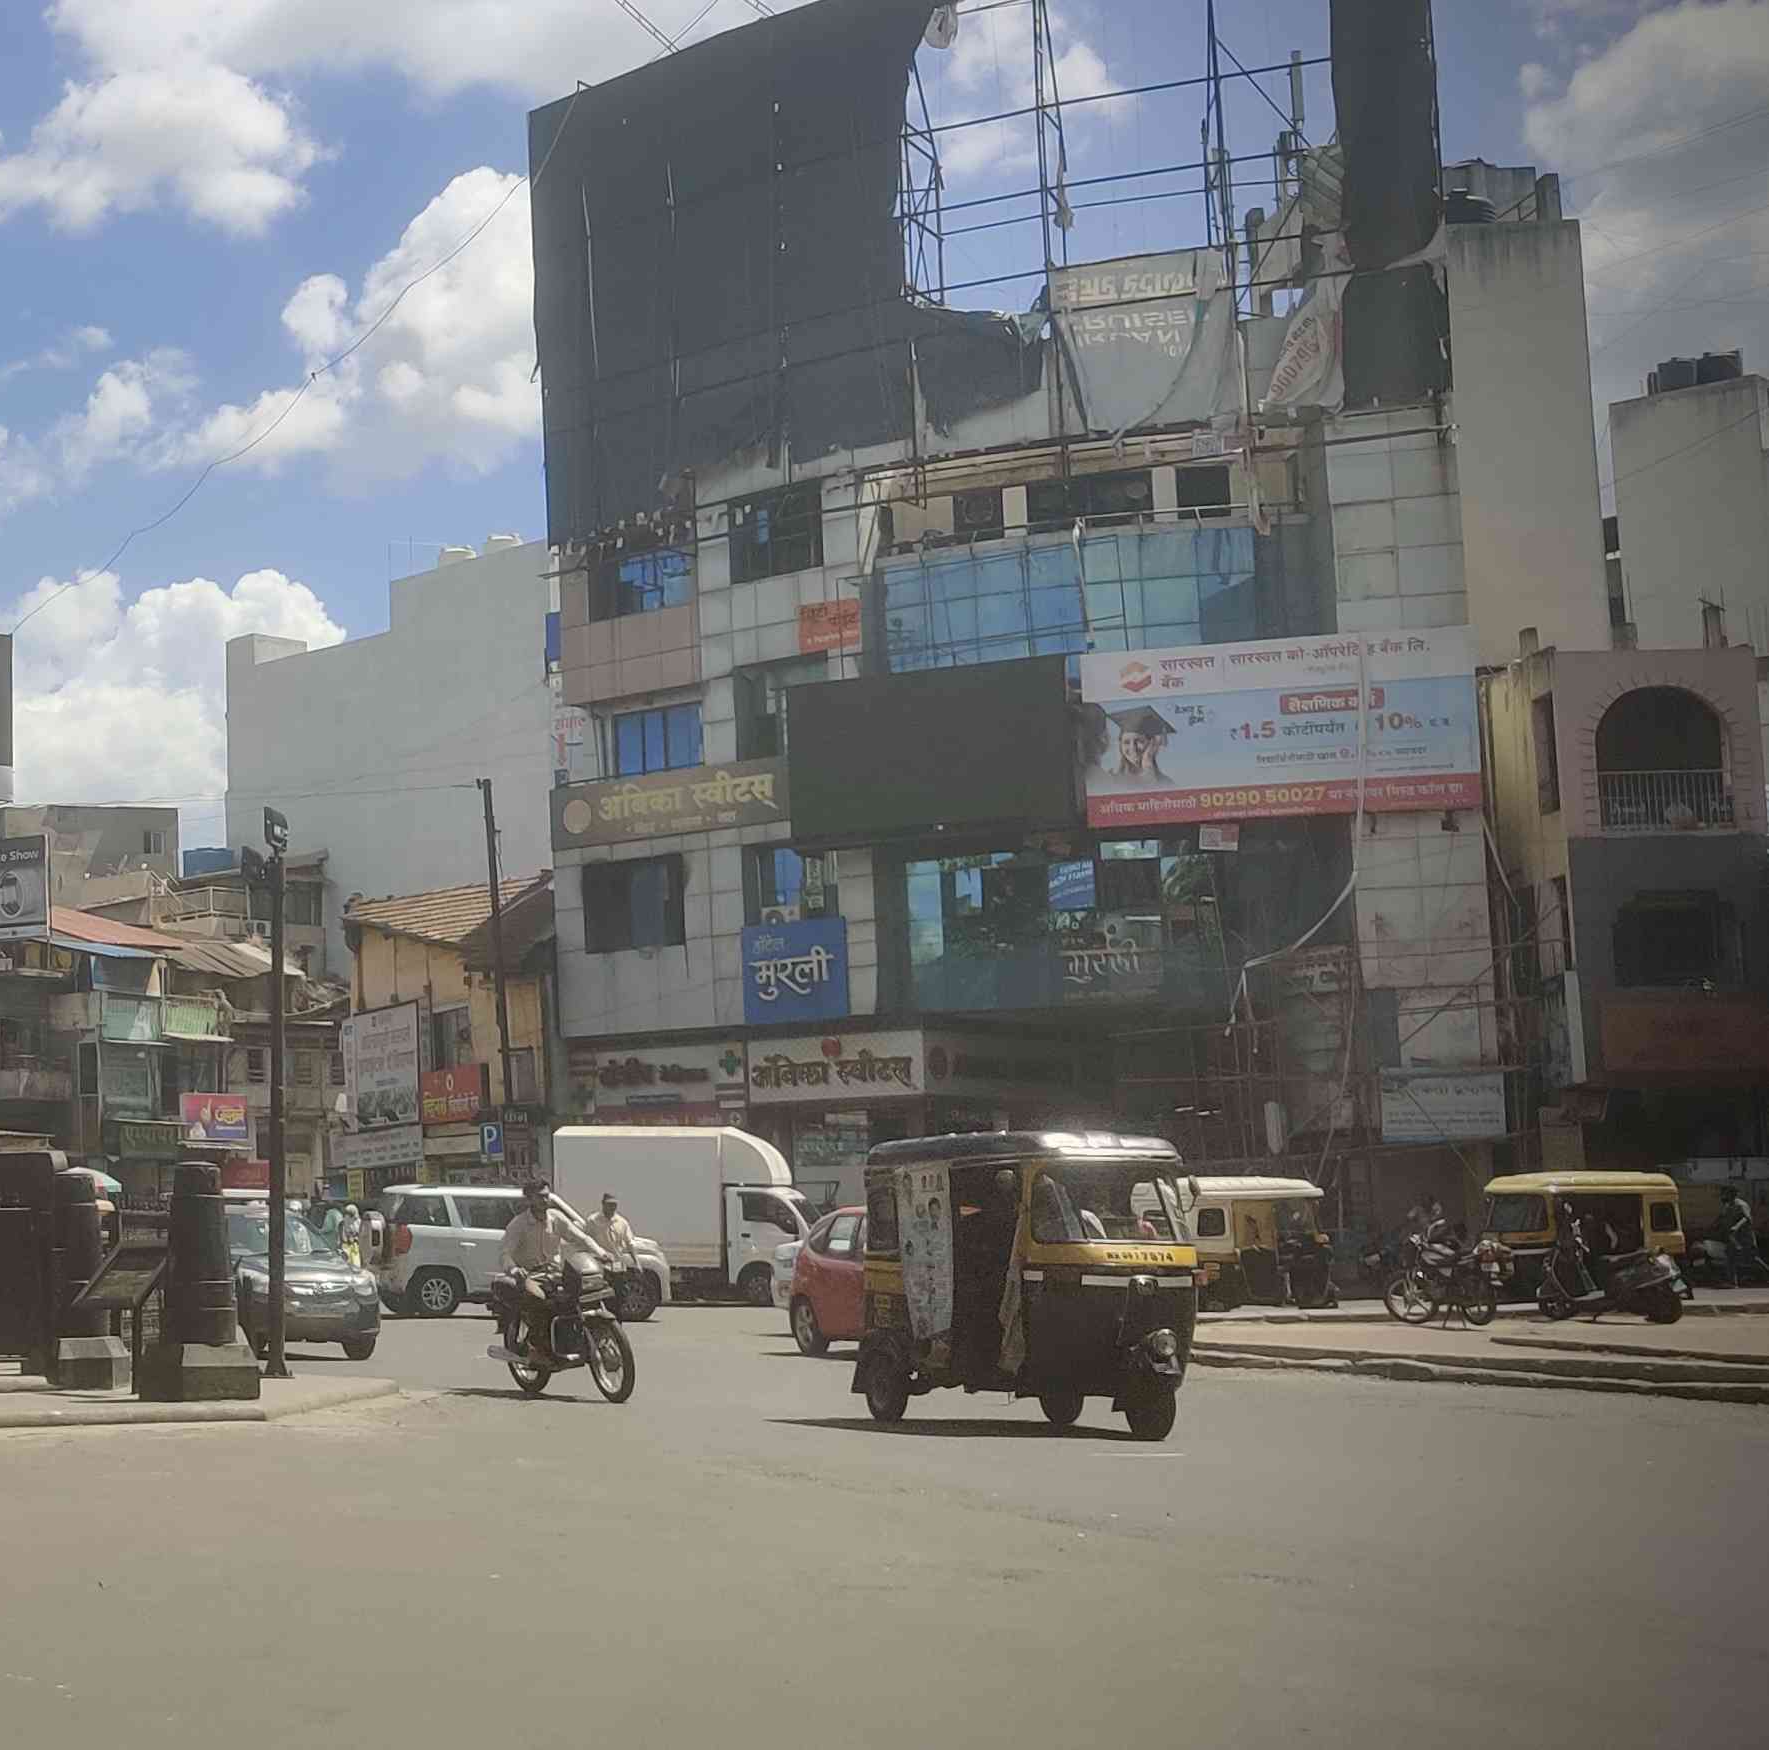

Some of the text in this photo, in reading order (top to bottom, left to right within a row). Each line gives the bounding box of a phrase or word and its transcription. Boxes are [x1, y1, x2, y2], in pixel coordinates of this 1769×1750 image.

[598, 783, 681, 821] अंबिका
[1199, 791, 1260, 808] 90290
[1263, 786, 1327, 804] 50027
[9, 850, 40, 861] Show
[749, 945, 834, 1001] मुरली
[483, 1125, 497, 1153] P
